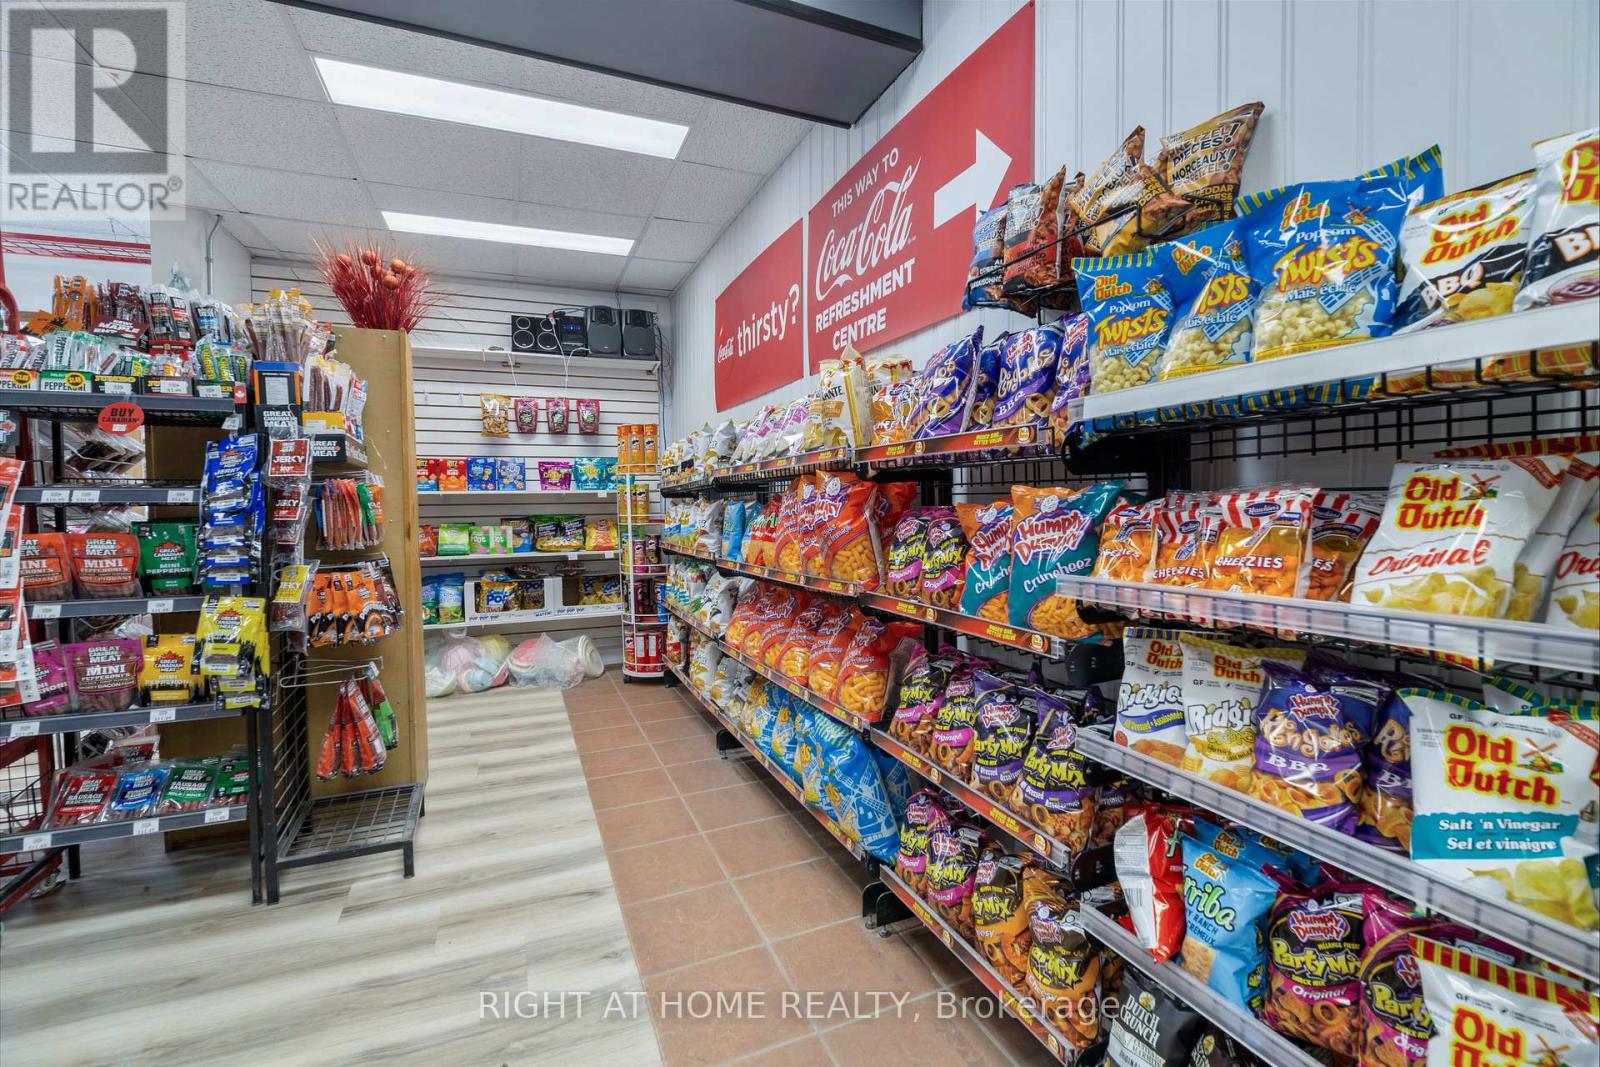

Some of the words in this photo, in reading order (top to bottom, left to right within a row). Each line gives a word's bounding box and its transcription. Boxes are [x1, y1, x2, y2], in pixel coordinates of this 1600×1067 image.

[832, 194, 853, 218] THIS
[855, 163, 878, 196] WAY
[883, 148, 899, 173] TO
[815, 156, 921, 301] Coca-Cola
[1431, 201, 1493, 243] Old
[1422, 216, 1520, 265] Dutch
[1274, 236, 1380, 293] Twists
[1095, 274, 1118, 287] Old
[1095, 282, 1132, 301] Dutch
[1420, 263, 1484, 311] BBQ
[815, 258, 915, 333] REFRESHMENT
[1286, 286, 1316, 302] Maïs
[1109, 300, 1151, 314] Popcorn
[737, 284, 799, 357] thirsty?
[833, 308, 886, 351] CENTRE
[1094, 308, 1168, 351] Twists
[272, 456, 304, 464] JERKY
[1406, 476, 1460, 501] Old
[1398, 502, 1487, 529] Dutch
[21, 560, 48, 568] INI
[84, 559, 124, 568] MINI
[1215, 556, 1284, 570] CHEEZIES
[1368, 539, 1491, 576] Original
[1024, 558, 1092, 593] Cruncheez
[89, 655, 121, 663] MEAT
[1150, 641, 1173, 655] Old
[87, 665, 126, 676] MINI
[1146, 653, 1183, 670] Dutch
[1214, 655, 1243, 670] Old
[1214, 666, 1261, 683] Dutch
[1187, 698, 1257, 736] Ridgi
[974, 736, 1000, 759] arty
[1448, 726, 1514, 764] Old
[1024, 746, 1051, 779] Party
[1052, 763, 1086, 786] Mix
[1264, 755, 1330, 772] BBQ
[1448, 758, 1557, 805] Dutch
[1439, 819, 1473, 831] Salt
[1496, 819, 1560, 831] Vinegar
[1447, 839, 1473, 850] Sel
[1476, 839, 1492, 850] et
[1495, 838, 1557, 853] vinaigre
[1185, 877, 1237, 932] rriba
[1294, 912, 1342, 927] Humpty
[1187, 920, 1216, 945] REMEUX
[1292, 924, 1342, 941] Dumpty
[1271, 938, 1326, 973] Party
[1292, 985, 1347, 999] Original
[1127, 994, 1160, 1029] DUTCH
[1120, 1005, 1160, 1048] CRUNCH
[1454, 1008, 1521, 1058] Old
